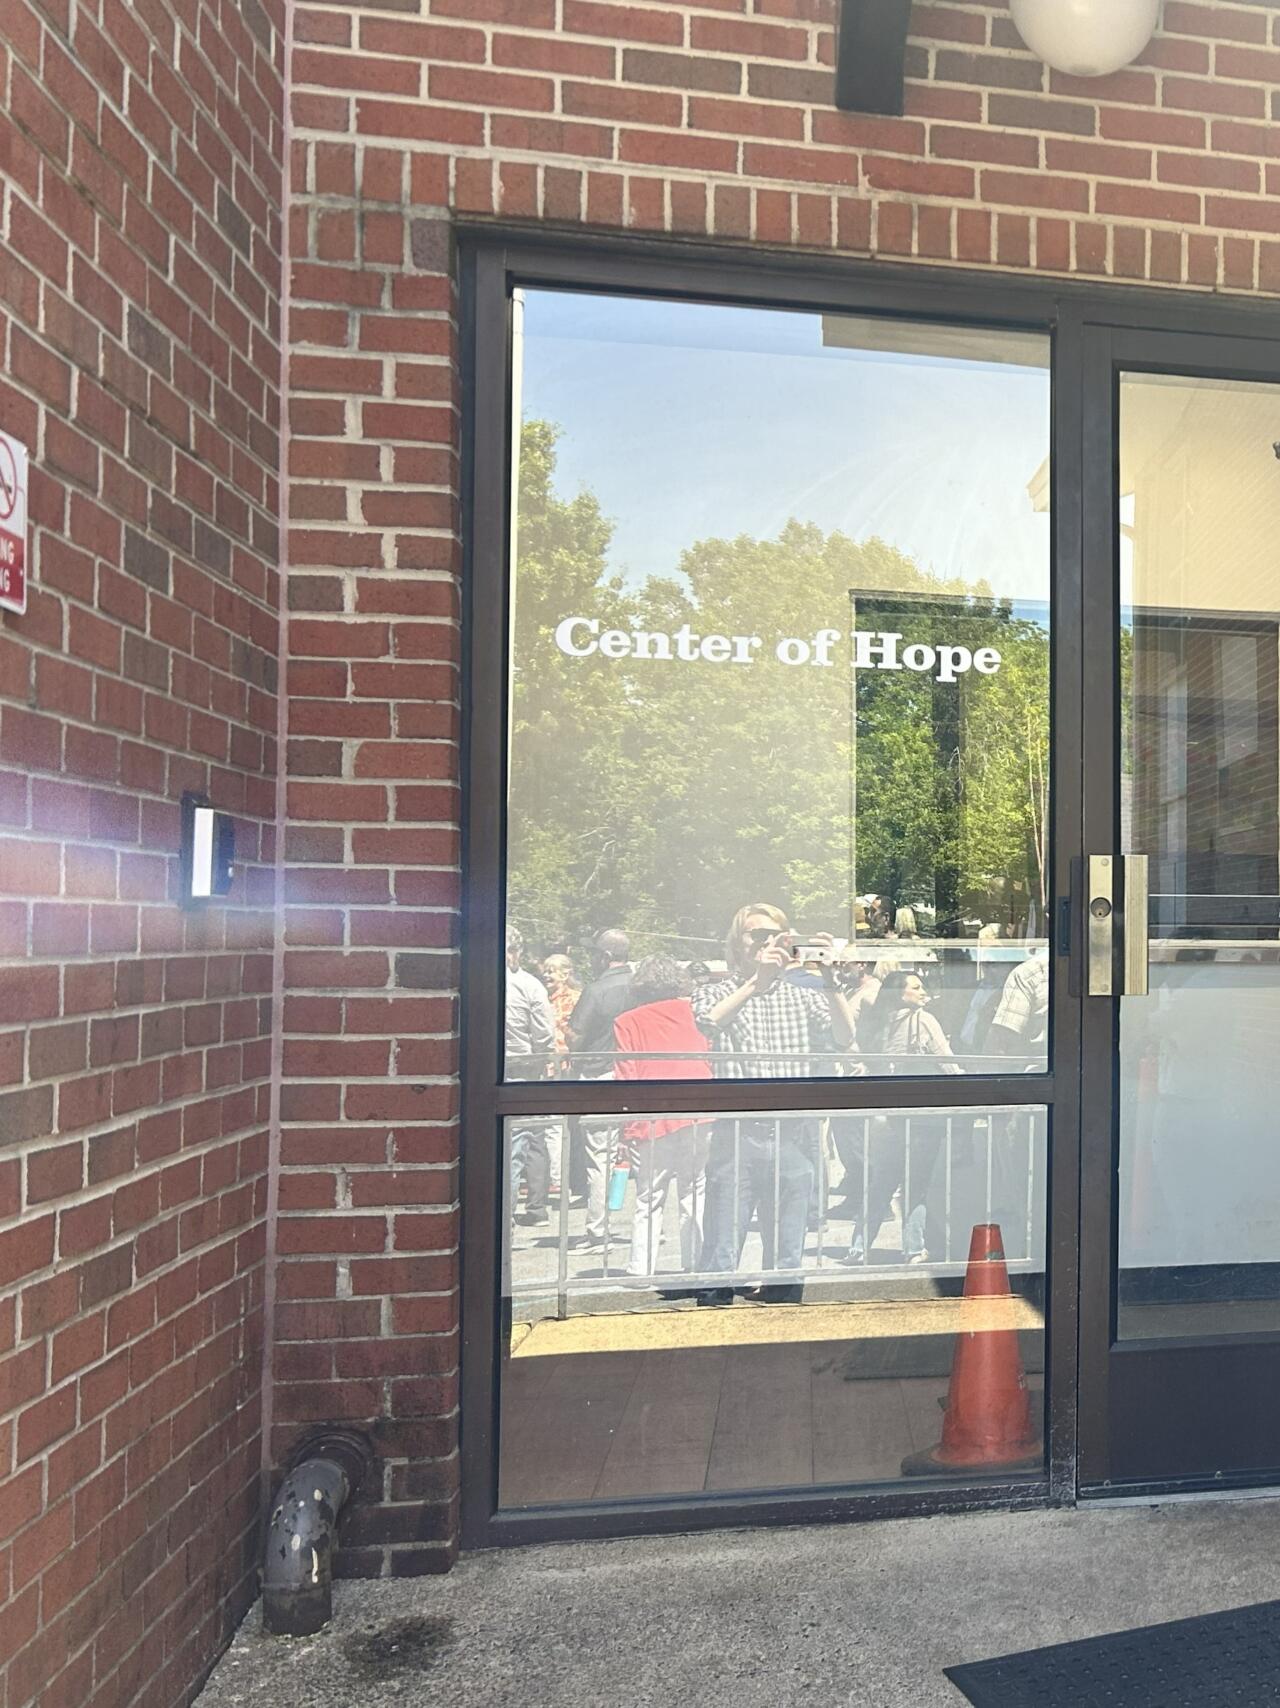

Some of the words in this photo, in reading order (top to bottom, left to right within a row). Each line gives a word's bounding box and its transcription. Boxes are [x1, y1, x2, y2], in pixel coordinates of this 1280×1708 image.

[554, 616, 763, 665] Center
[776, 629, 842, 667] of
[850, 630, 1002, 683] Hope
